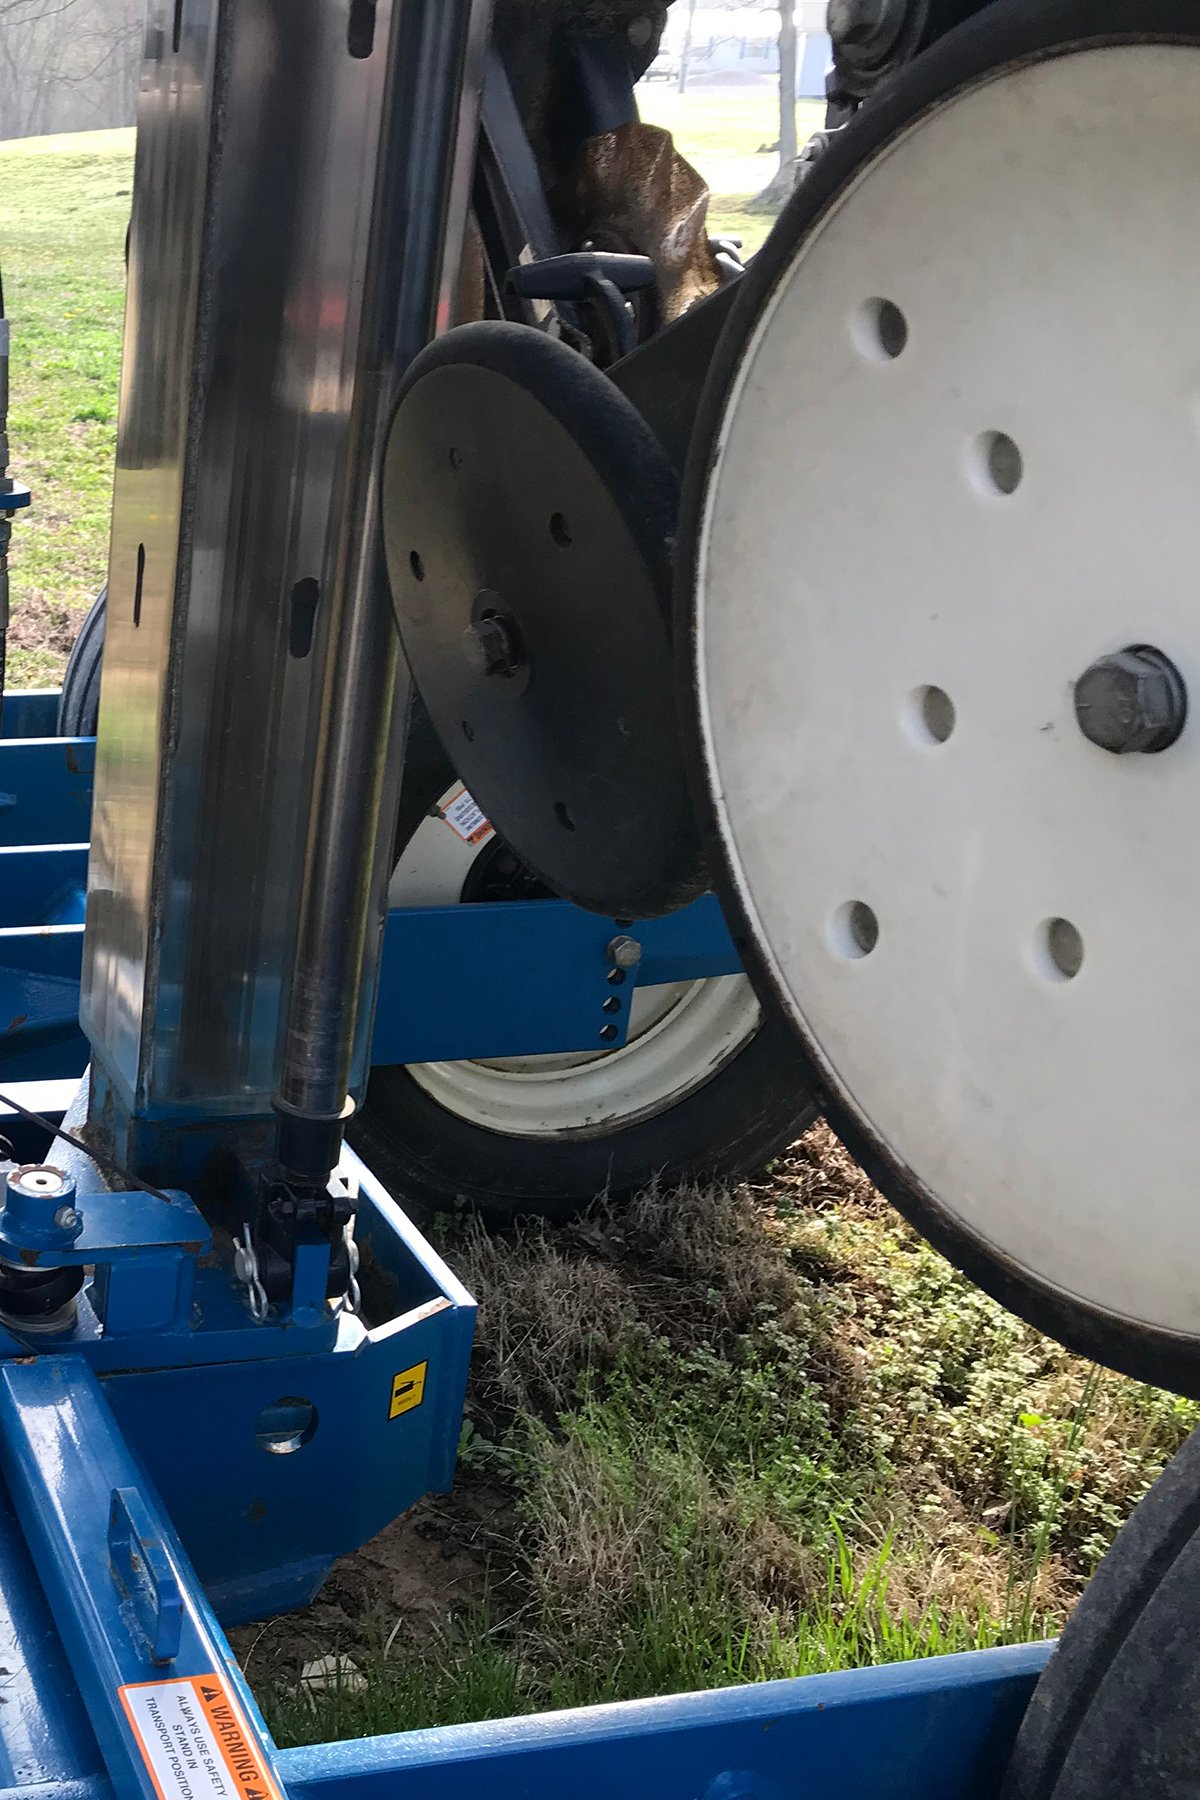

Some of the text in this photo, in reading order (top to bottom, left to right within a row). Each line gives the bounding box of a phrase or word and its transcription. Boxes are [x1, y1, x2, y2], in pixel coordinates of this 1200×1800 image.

[145, 1697, 175, 1754] TRANSPORT
[172, 1725, 199, 1770] STAND IN
[176, 1695, 228, 1796] ALWAYS USE SAFETY
[211, 1705, 259, 1782] WARNING
